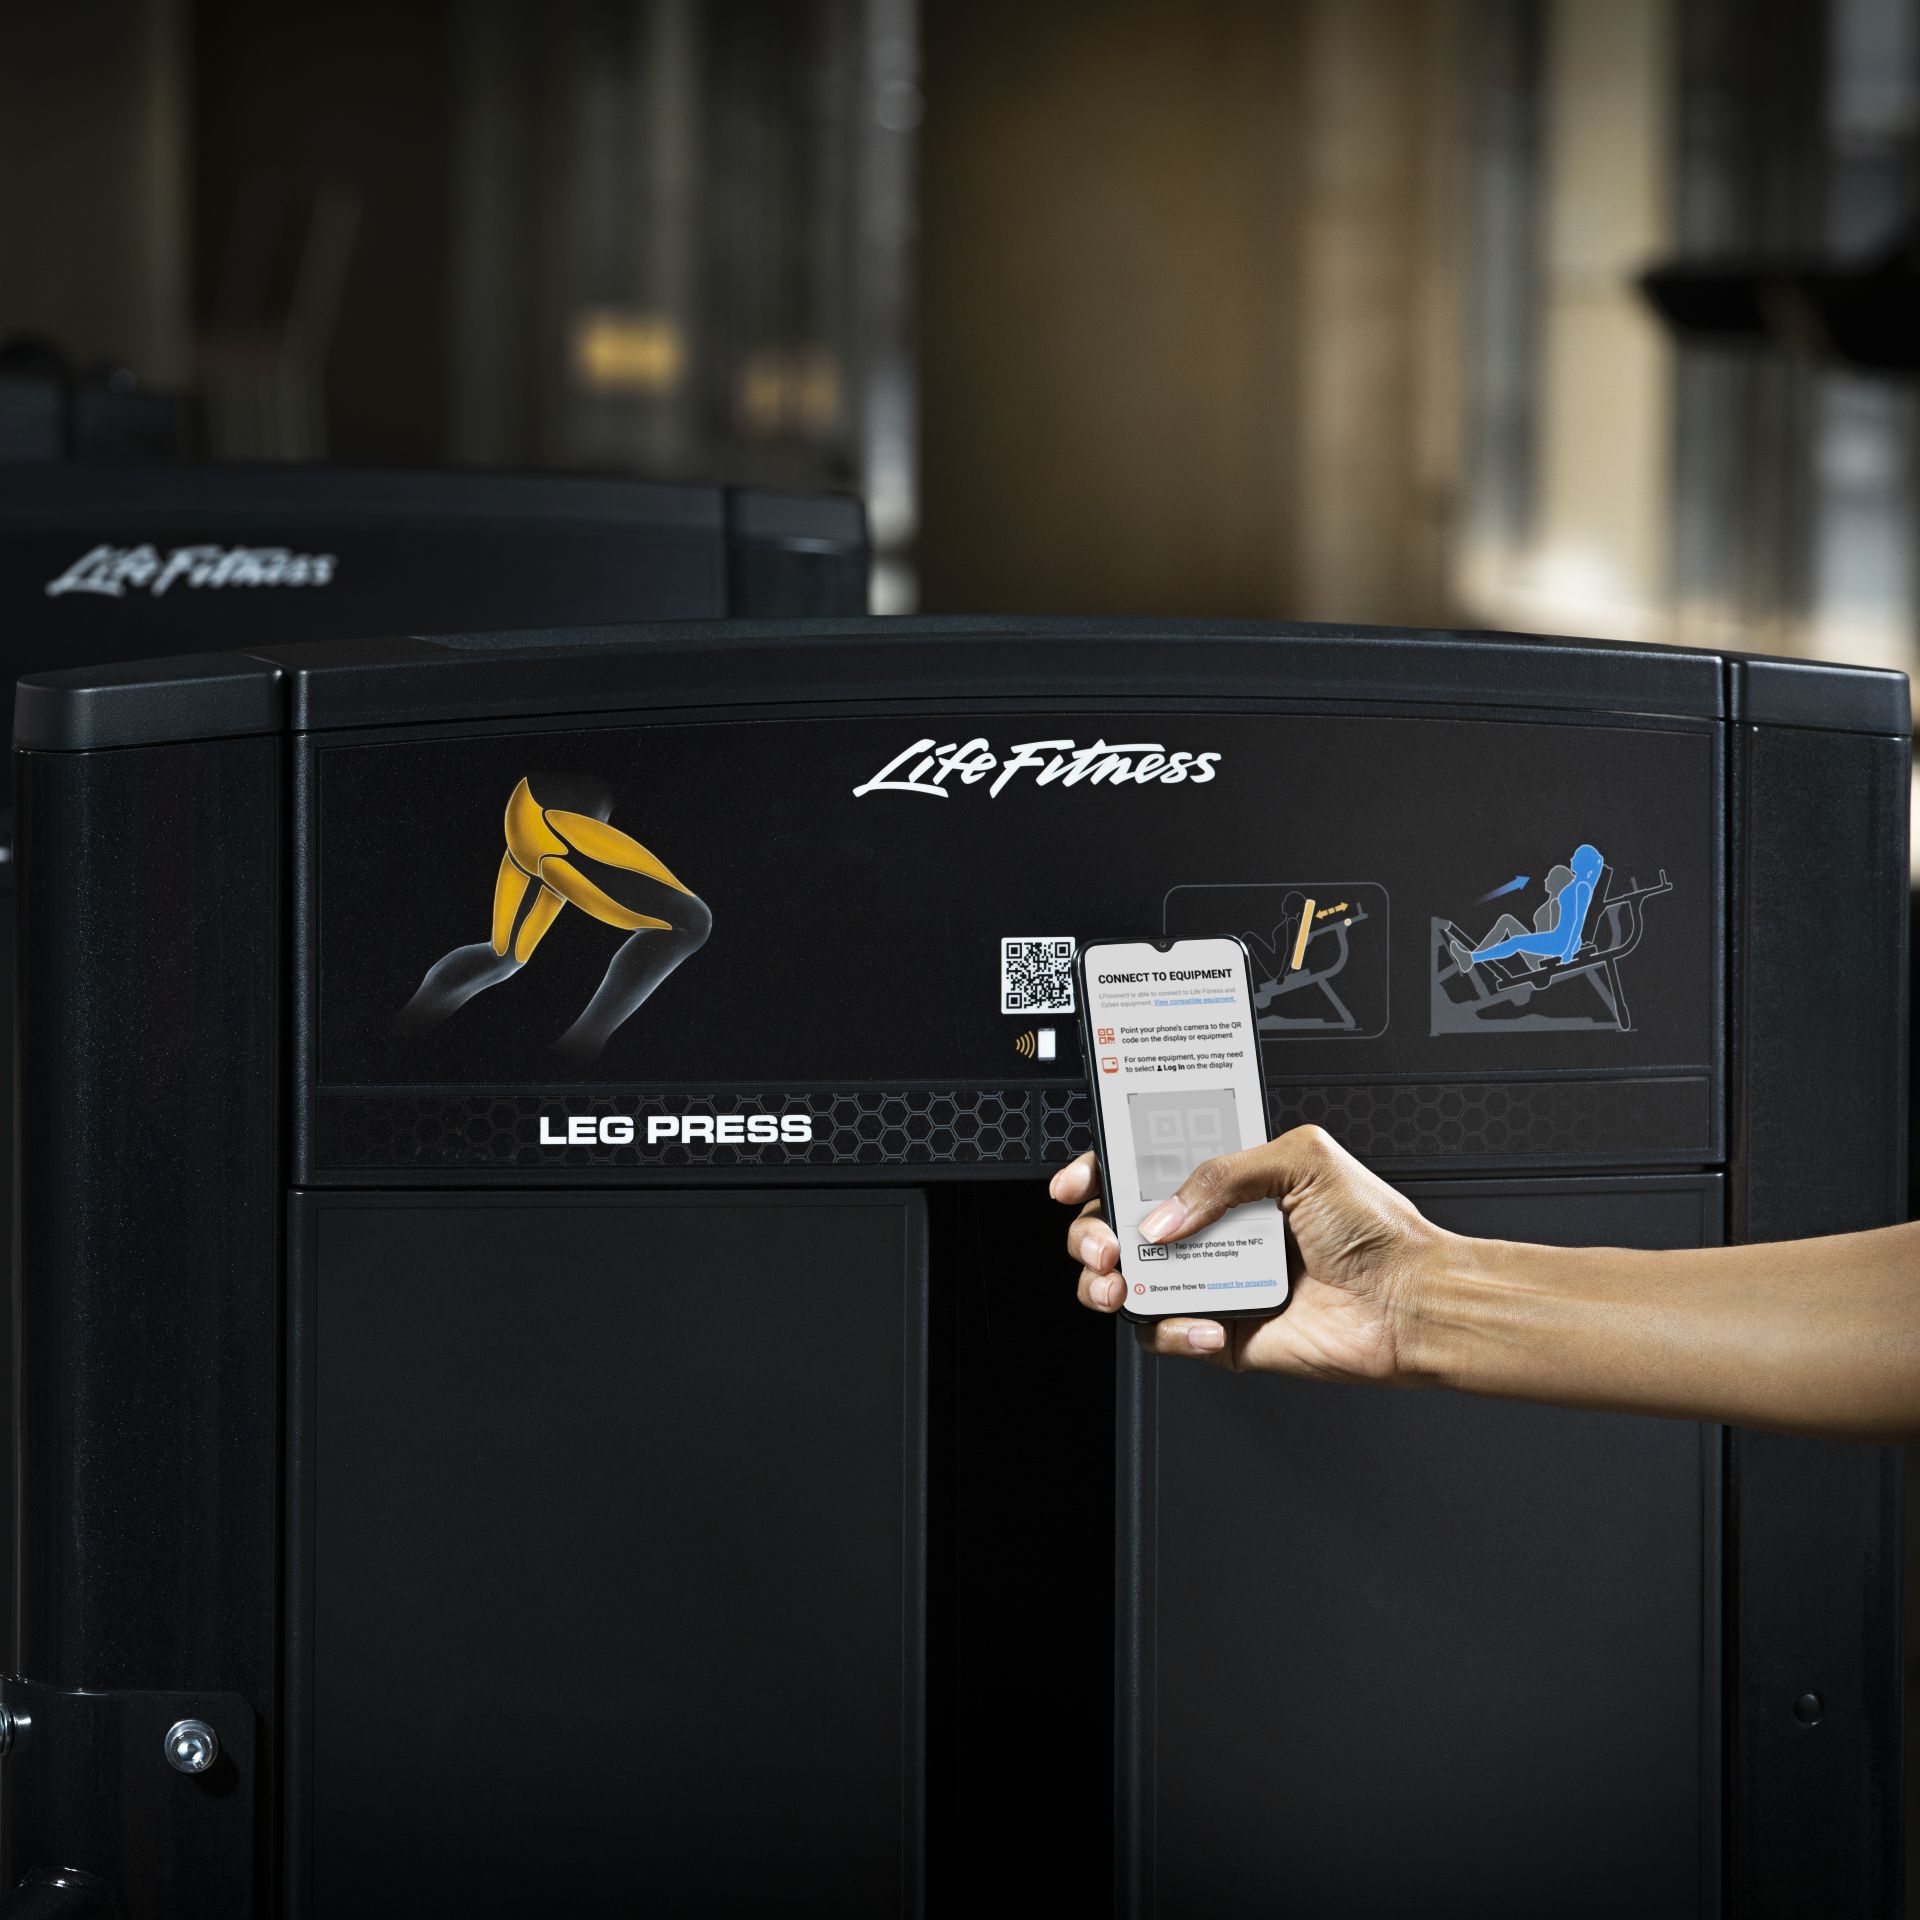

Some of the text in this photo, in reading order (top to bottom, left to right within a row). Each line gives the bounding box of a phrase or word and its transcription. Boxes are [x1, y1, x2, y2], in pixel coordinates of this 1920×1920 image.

[852, 738, 1222, 799] Life Fitness
[1098, 969, 1232, 984] CONNECT TO EQUIPMENT
[1190, 987, 1201, 995] Life
[1201, 986, 1224, 994] Fitness
[1120, 1026, 1139, 1034] Point
[1139, 1026, 1155, 1035] your
[1156, 1024, 1182, 1033] phone's
[1231, 1021, 1242, 1029] QR
[1121, 1035, 1139, 1044] code
[1150, 1034, 1162, 1043] the
[1162, 1033, 1187, 1043] display
[1196, 1032, 1233, 1041] equipment
[1157, 1053, 1196, 1063] equipment,
[1196, 1054, 1210, 1062] you
[1126, 1065, 1134, 1073] to
[1134, 1064, 1155, 1073] select
[1163, 1063, 1177, 1072] Log
[1209, 1060, 1233, 1070] display
[540, 1114, 812, 1145] LEG PRESS
[1175, 1242, 1188, 1250] Tap
[1188, 1241, 1204, 1250] your
[1205, 1240, 1227, 1249] phone
[1236, 1238, 1248, 1246] the
[1248, 1238, 1264, 1246] NFC
[1142, 1247, 1165, 1257] NFC
[1175, 1252, 1192, 1260] logo
[1202, 1250, 1215, 1258] the
[1214, 1248, 1239, 1258] display
[1150, 1284, 1169, 1292] Show
[1207, 1281, 1235, 1290] connect
[1235, 1280, 1245, 1289] by
[1245, 1279, 1278, 1288] proximity.
